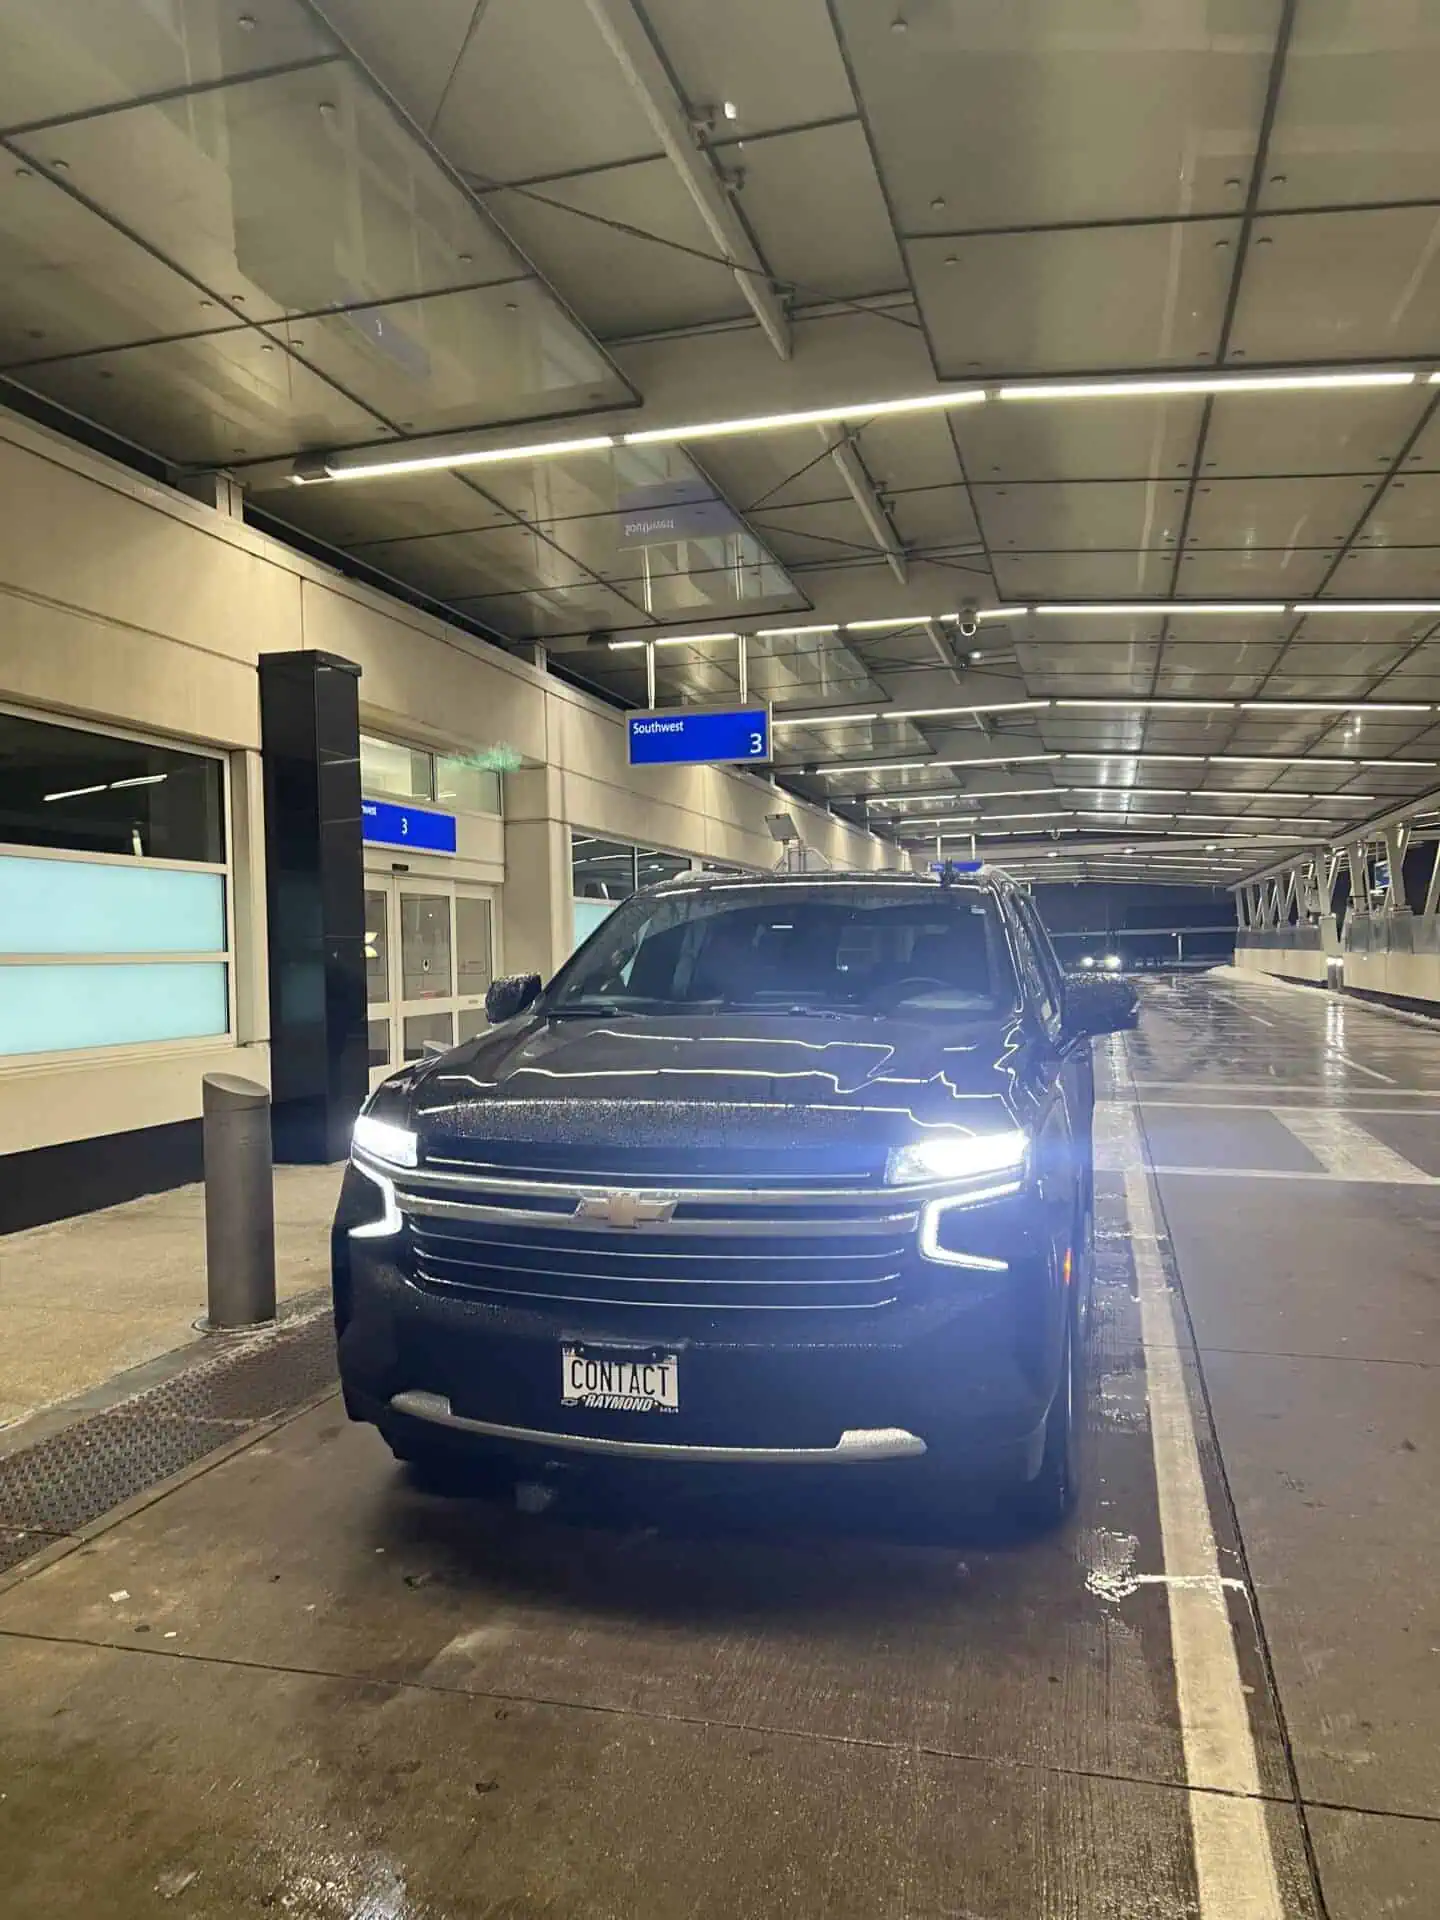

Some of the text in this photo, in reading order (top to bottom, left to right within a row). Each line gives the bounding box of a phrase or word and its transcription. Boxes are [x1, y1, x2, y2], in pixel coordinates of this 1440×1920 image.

[632, 720, 684, 735] Southwest
[749, 733, 762, 753] 3
[401, 817, 408, 834] 3
[571, 1359, 669, 1396] CONTACT
[585, 1393, 653, 1412] RAYMOND
